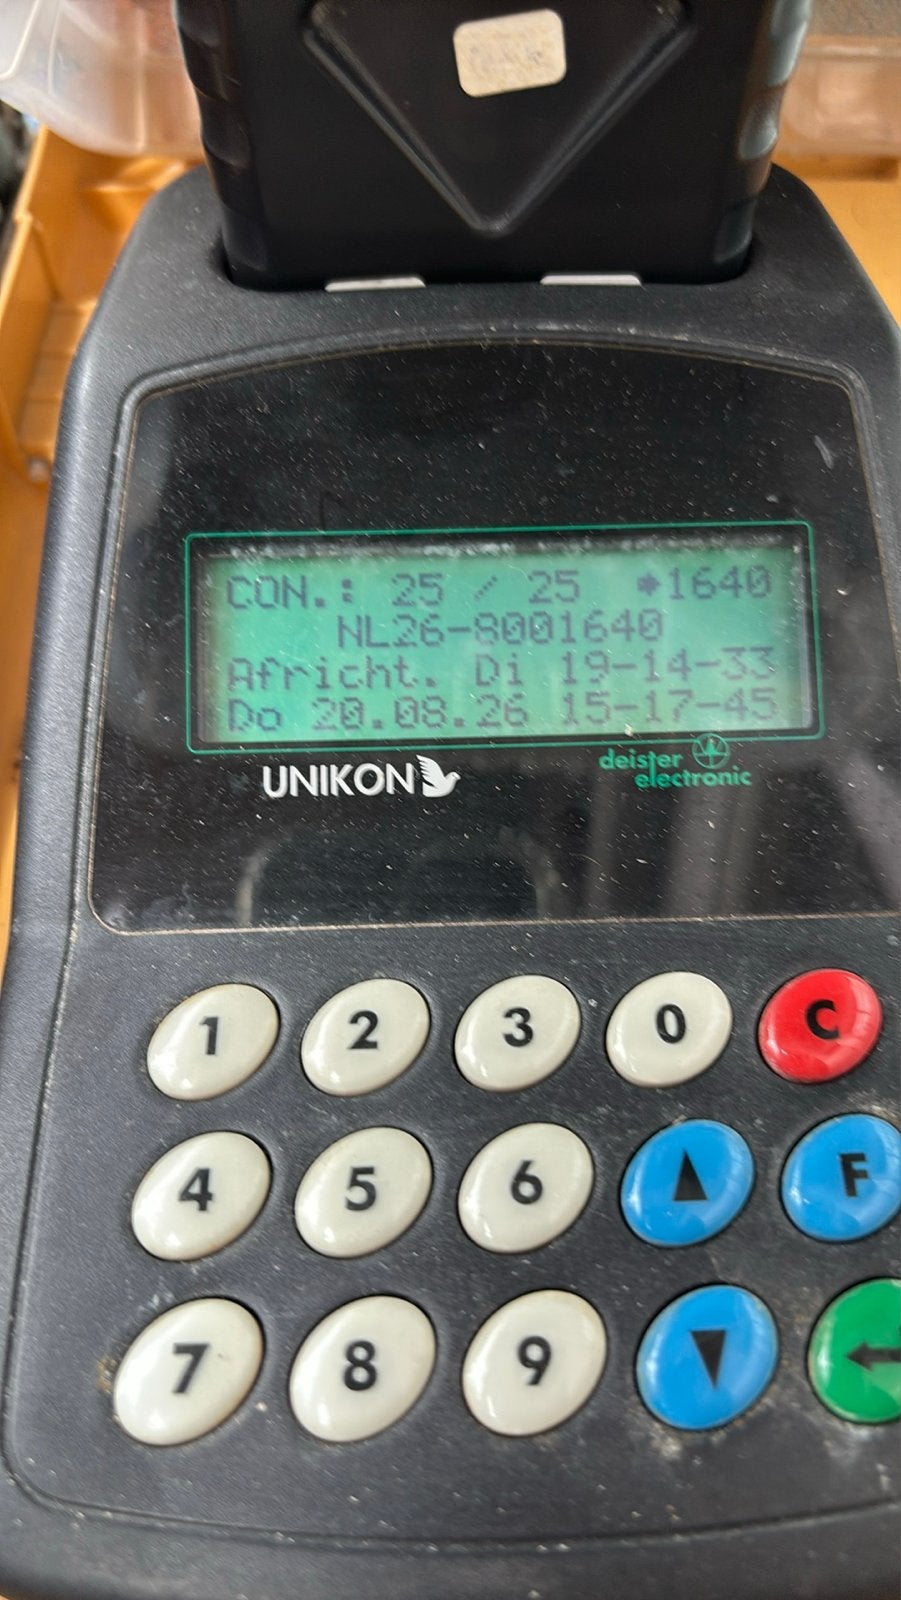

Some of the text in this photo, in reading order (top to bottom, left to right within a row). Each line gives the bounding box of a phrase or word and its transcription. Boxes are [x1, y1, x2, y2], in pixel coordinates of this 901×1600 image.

[226, 575, 353, 611] CON.:
[392, 573, 444, 606] 25
[528, 571, 580, 604] 25
[669, 565, 771, 600] 1640
[337, 608, 664, 649] NL26-8001640
[227, 647, 773, 691] Africht. Di 19-14-33
[226, 688, 778, 732] Do 20.08.26 15-17-45
[263, 763, 416, 798] UNIKON
[599, 748, 683, 773] deister
[635, 763, 752, 788] electronic
[201, 1016, 219, 1055] 1
[348, 1011, 380, 1050] 2
[503, 1007, 533, 1046] 3
[657, 1004, 686, 1044] 0
[805, 1000, 839, 1040] C
[180, 1168, 213, 1211] 4
[346, 1166, 377, 1211] 5
[511, 1160, 542, 1204] 6
[839, 1154, 868, 1197] F
[172, 1343, 210, 1393] 7
[344, 1340, 377, 1392] 8
[518, 1336, 551, 1385] 9
